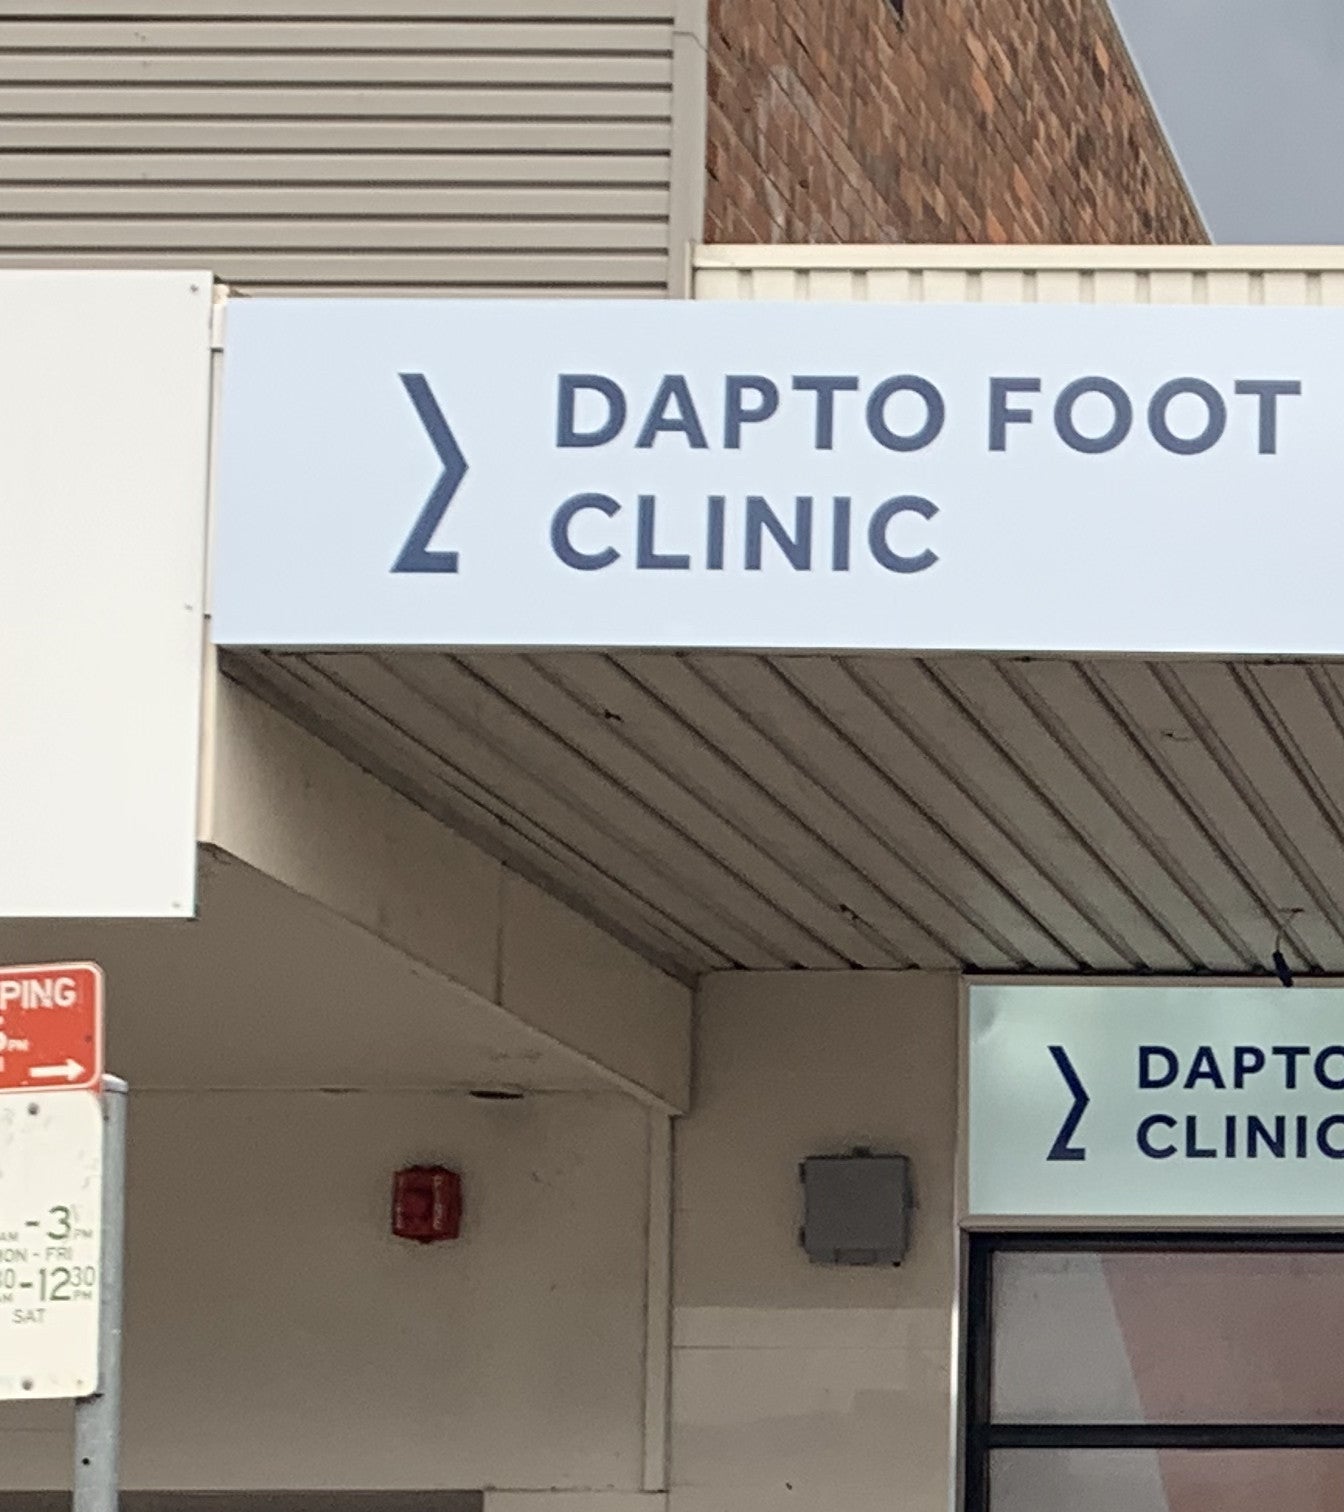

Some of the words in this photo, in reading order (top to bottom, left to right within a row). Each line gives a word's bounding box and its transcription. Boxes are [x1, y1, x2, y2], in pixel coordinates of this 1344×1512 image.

[555, 372, 947, 453] DAPTO
[988, 375, 1303, 455] FOOT
[550, 492, 940, 574] CLINIC
[0, 1247, 28, 1262] ON
[12, 1308, 46, 1324] SAT
